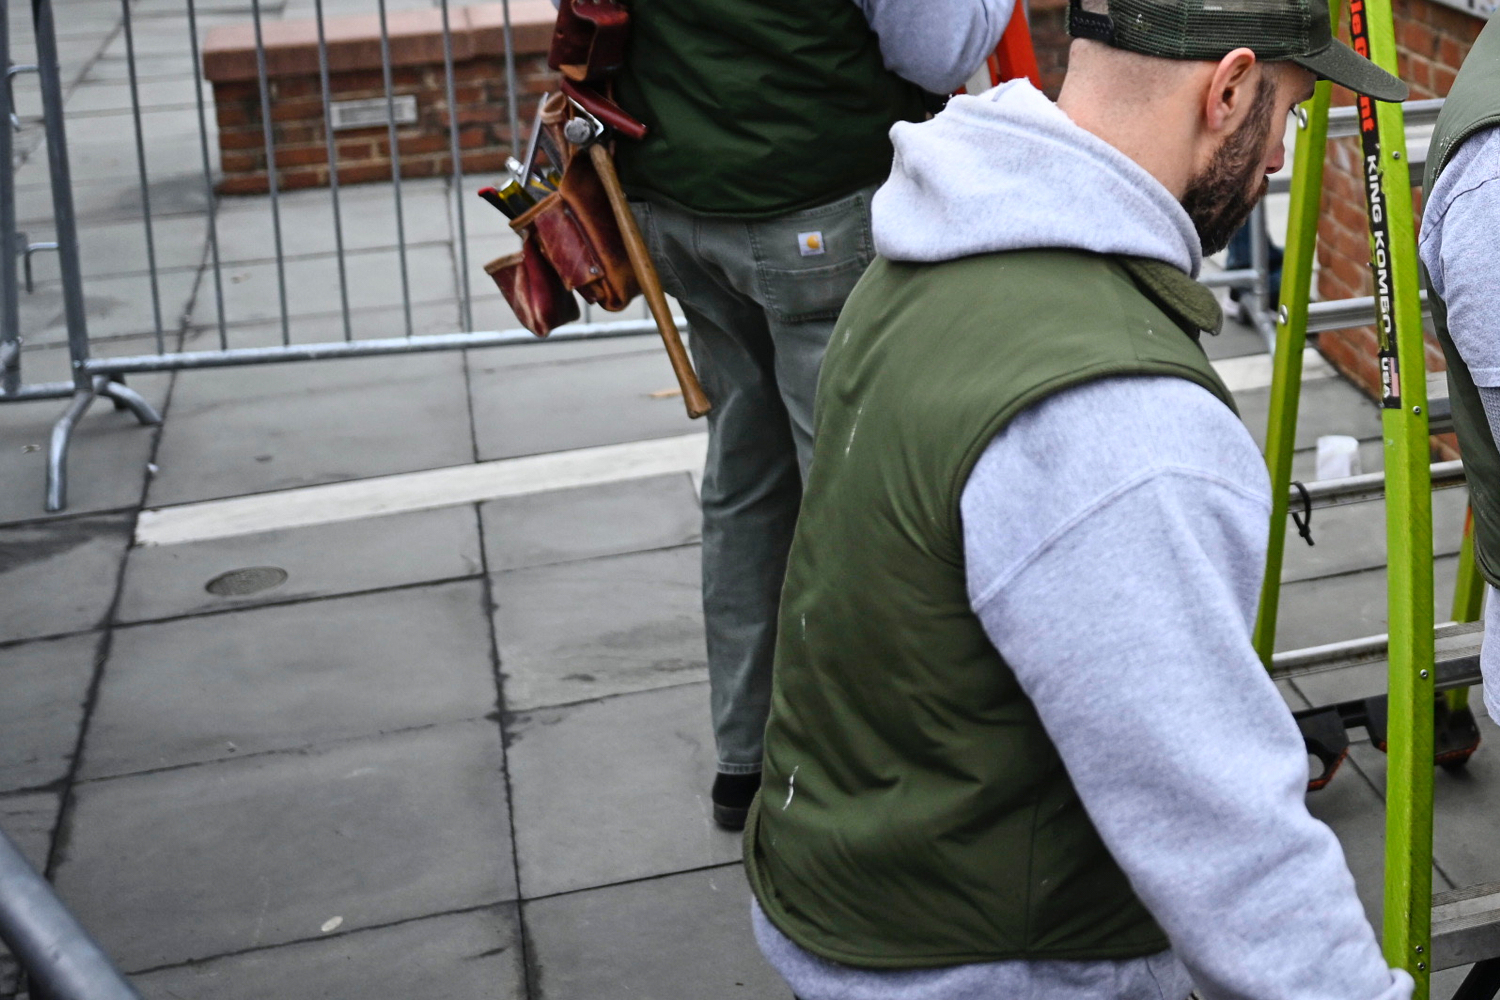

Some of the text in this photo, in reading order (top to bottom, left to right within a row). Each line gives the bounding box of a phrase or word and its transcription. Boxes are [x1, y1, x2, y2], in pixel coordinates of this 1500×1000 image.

[1366, 154, 1392, 335] KING KOMBO
[1381, 357, 1390, 399] USA
